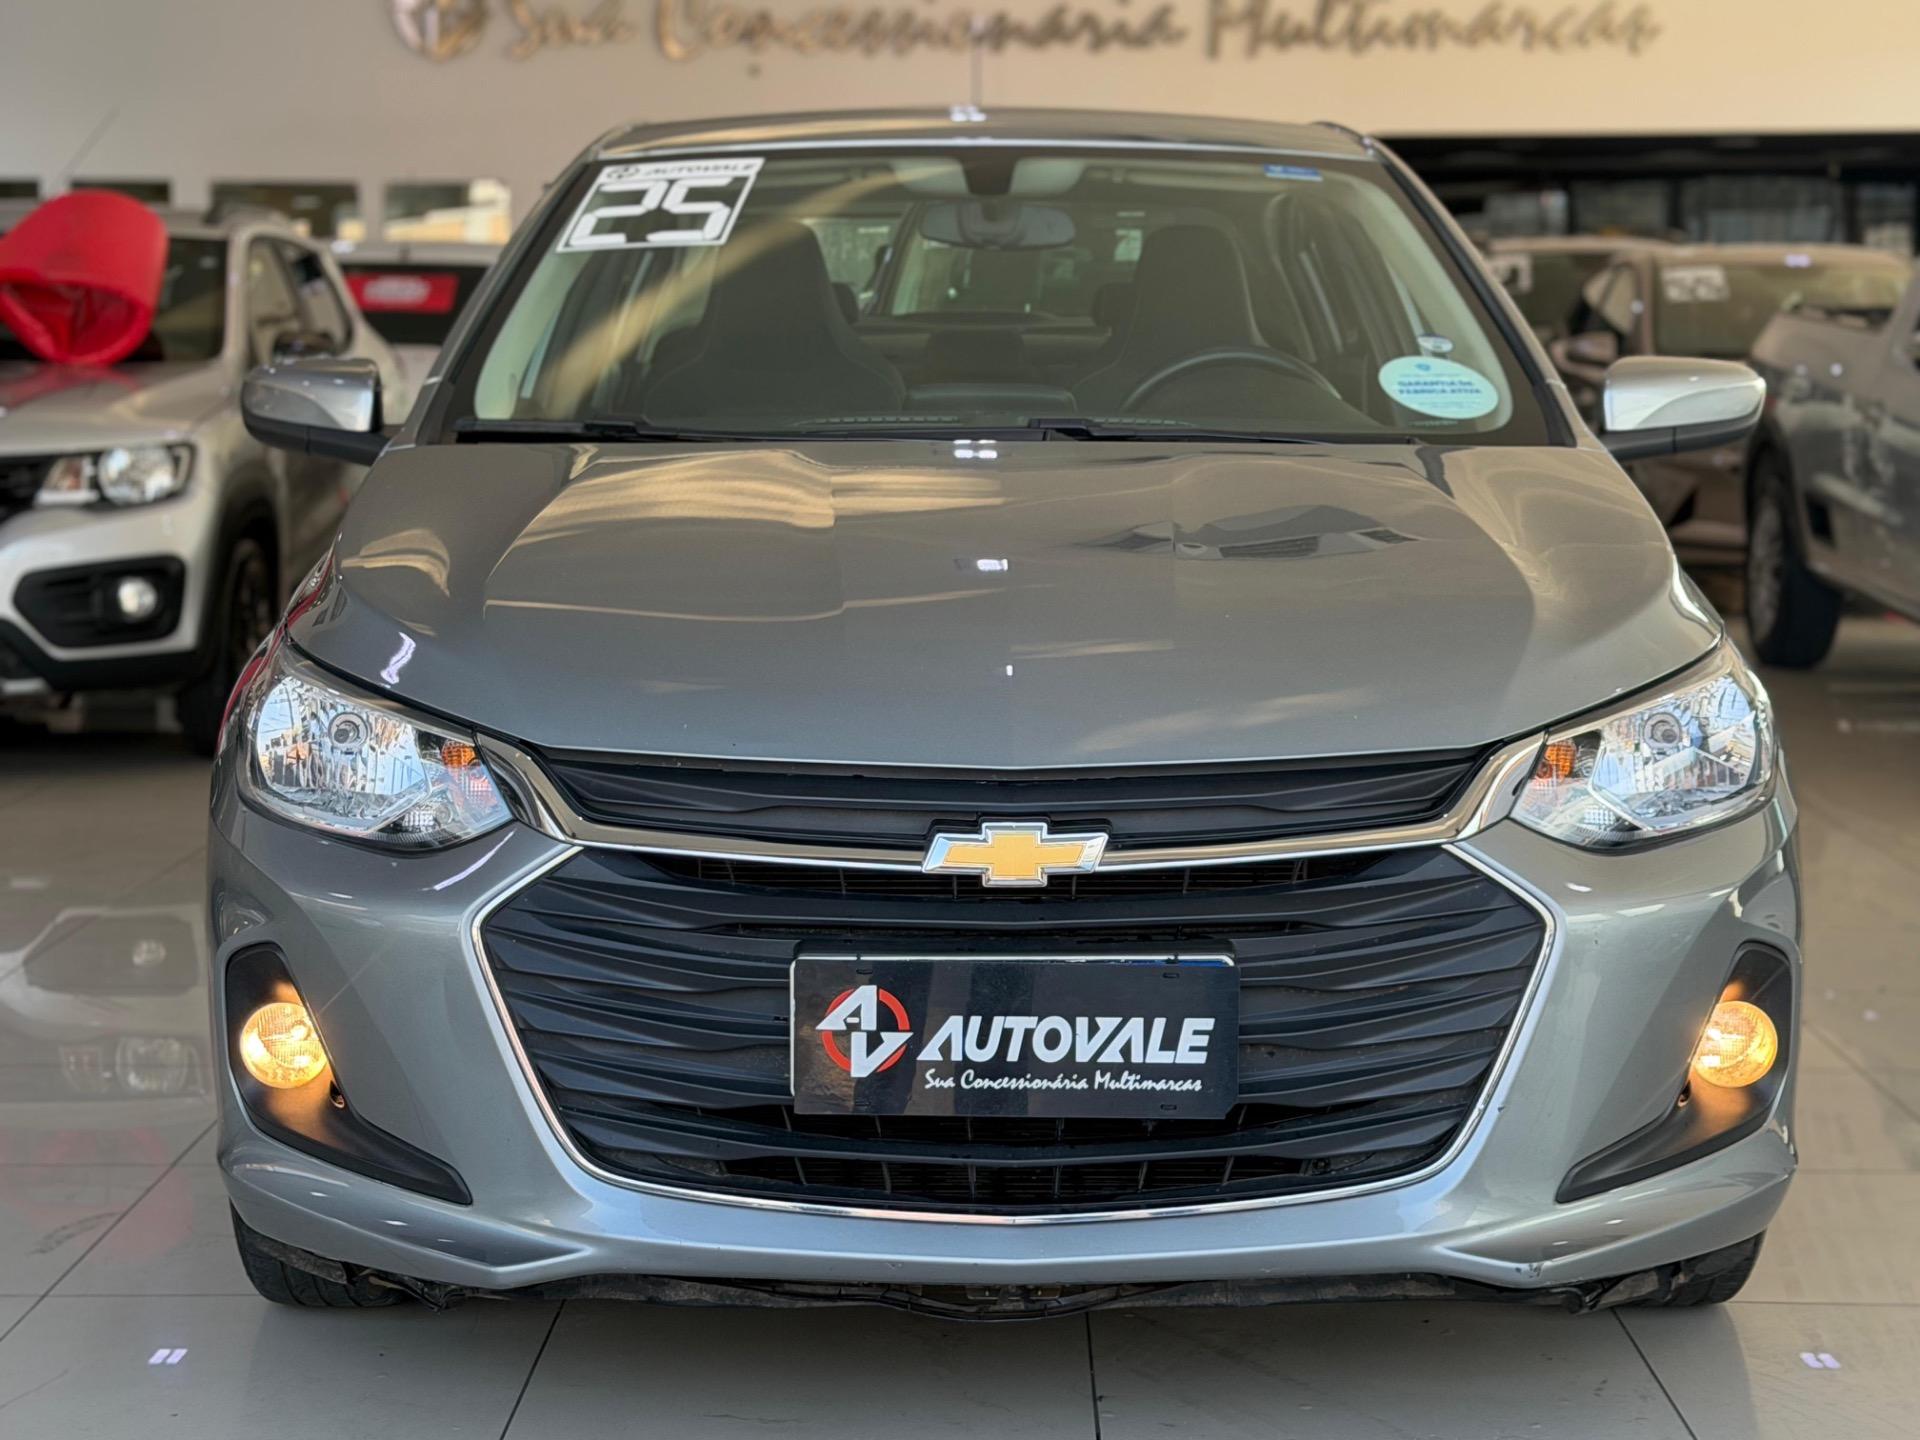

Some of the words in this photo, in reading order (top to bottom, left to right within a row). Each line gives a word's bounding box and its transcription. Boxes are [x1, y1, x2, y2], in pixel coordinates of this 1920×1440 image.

[569, 177, 731, 246] 25
[916, 1015, 1216, 1064] AUTOVALE
[924, 1068, 955, 1090] Sua
[960, 1068, 1090, 1091] Concessionária
[1094, 1070, 1203, 1092] Multimarcas
